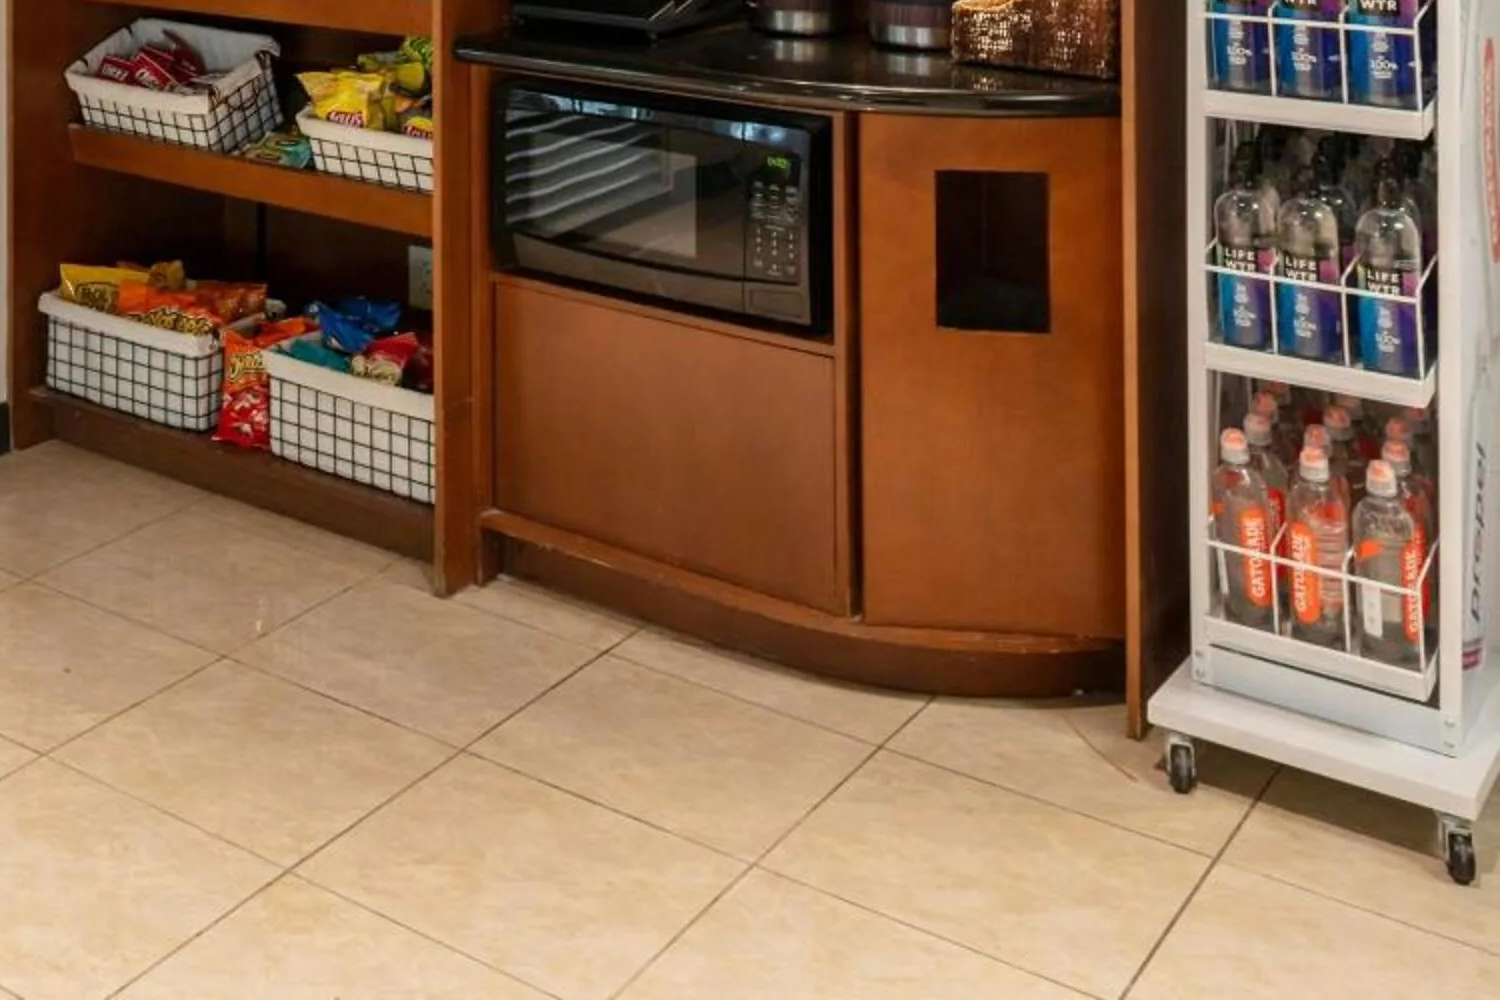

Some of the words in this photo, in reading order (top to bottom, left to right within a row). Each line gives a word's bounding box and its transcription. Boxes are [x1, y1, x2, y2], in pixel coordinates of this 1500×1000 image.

[1225, 248, 1255, 260] LIFE
[1226, 261, 1256, 272] WTR
[1286, 256, 1317, 270] LIFE
[1287, 271, 1317, 282] WTR
[1367, 268, 1400, 281] LIFE
[1368, 283, 1400, 296] WTR
[1243, 517, 1266, 598] GATOADE
[1293, 530, 1308, 613] GATOADE
[1404, 549, 1418, 633] GATOADE
